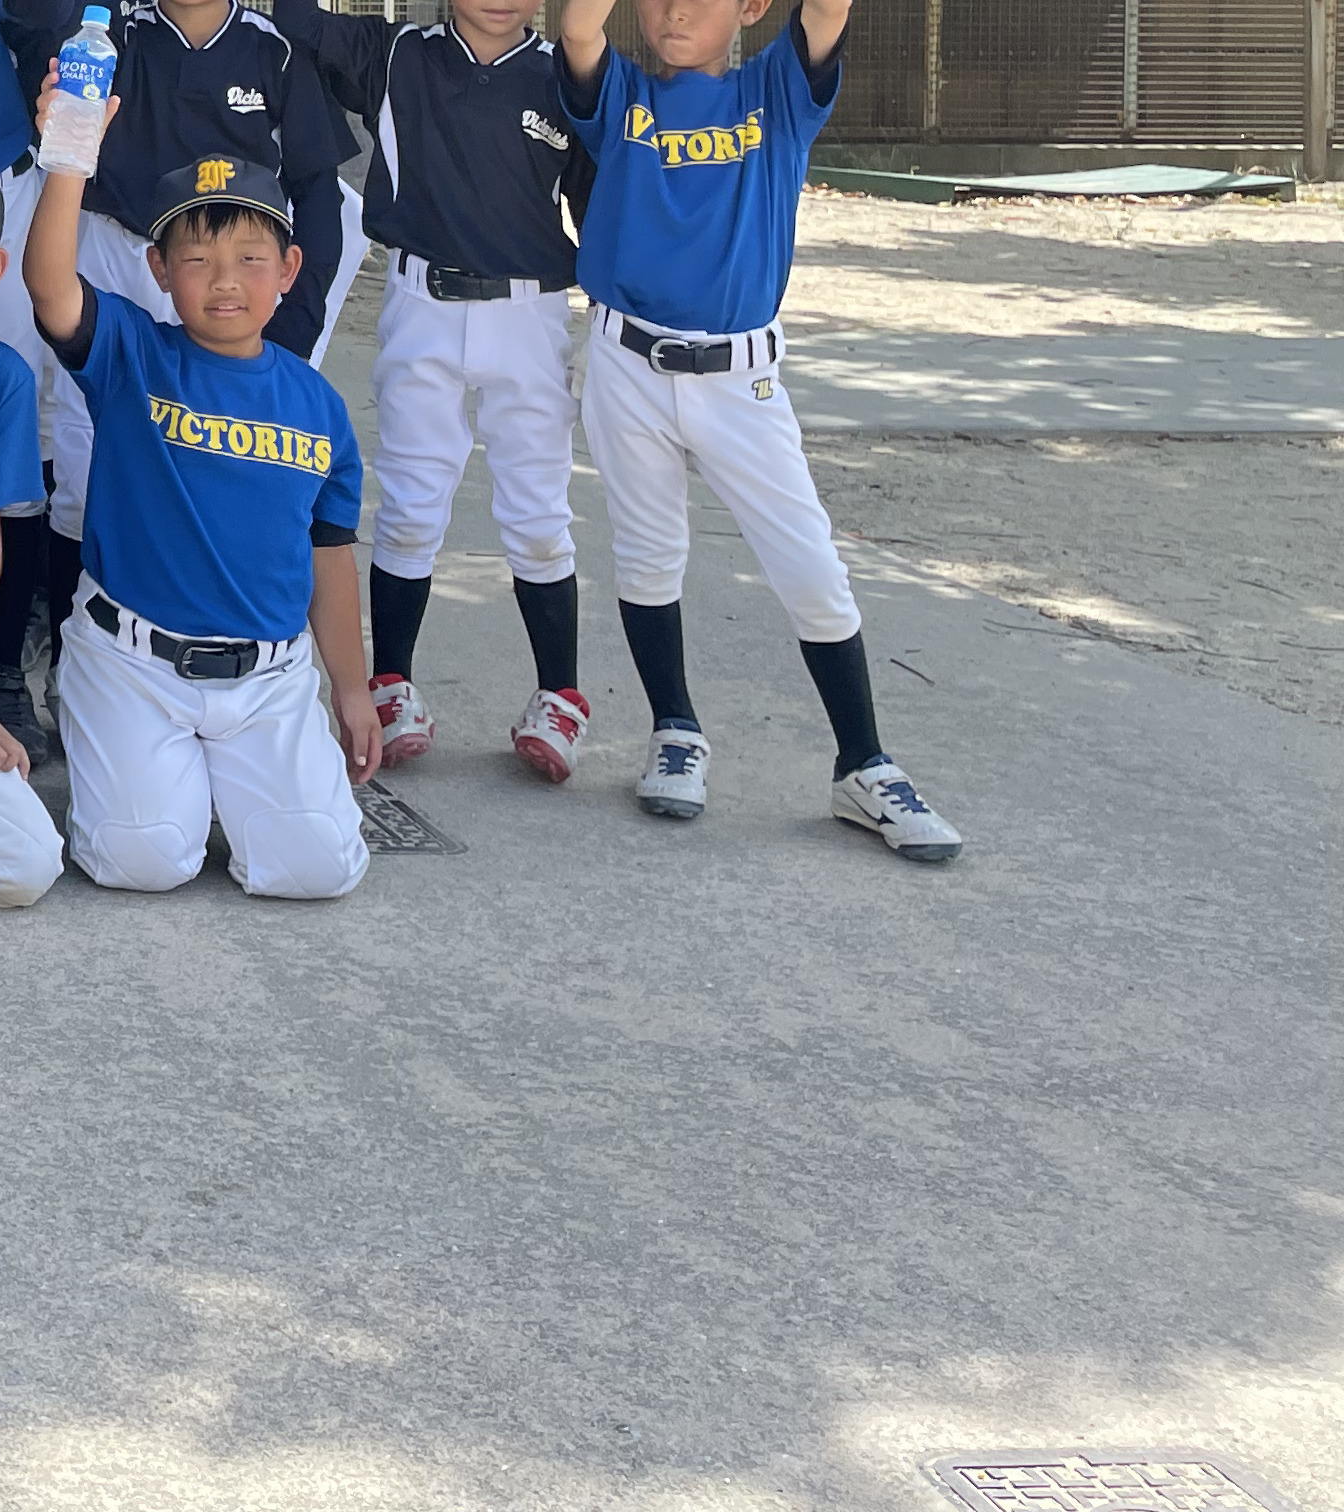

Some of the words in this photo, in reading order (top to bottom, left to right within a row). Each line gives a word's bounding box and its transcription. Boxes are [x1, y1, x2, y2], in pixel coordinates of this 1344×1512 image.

[59, 61, 105, 79] SPORTS
[521, 109, 570, 147] Victories
[149, 399, 332, 473] VICTORIES
